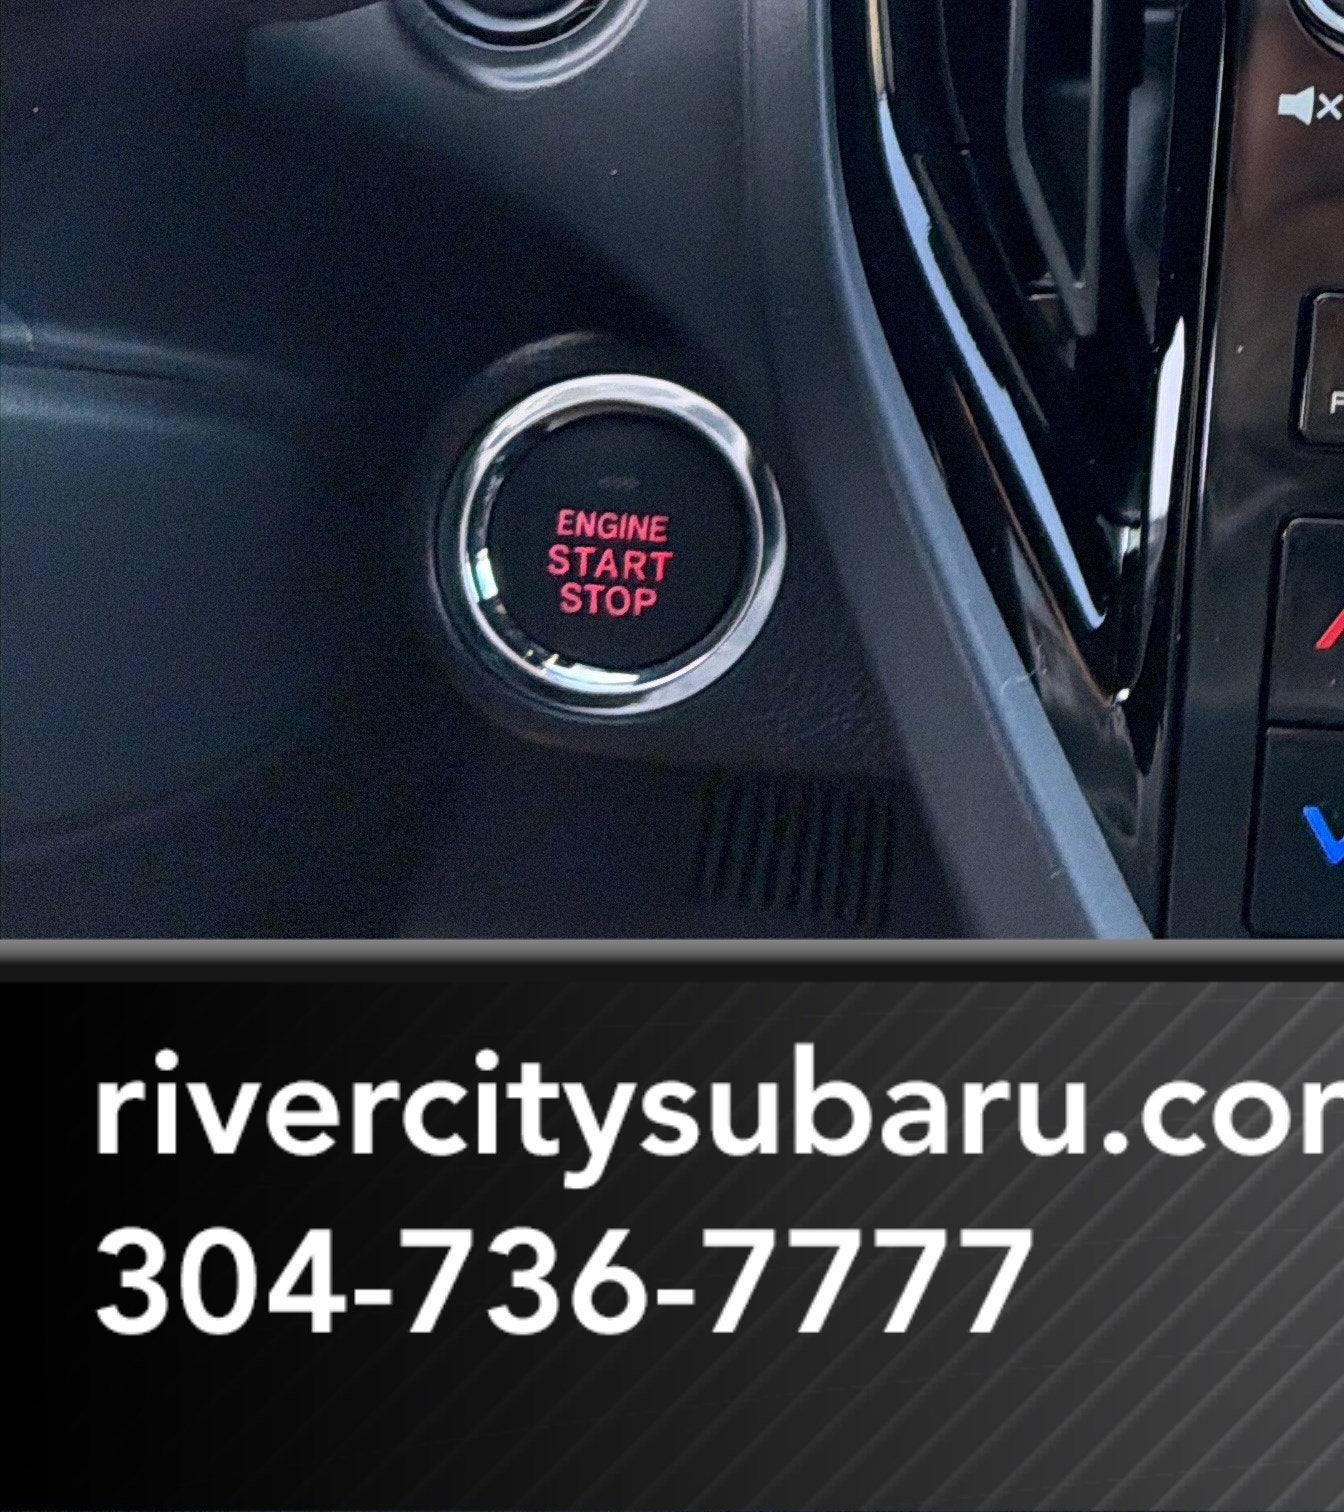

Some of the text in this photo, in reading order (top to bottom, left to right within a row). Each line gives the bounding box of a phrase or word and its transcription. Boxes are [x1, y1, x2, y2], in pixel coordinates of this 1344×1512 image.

[554, 506, 672, 545] ENGINE
[544, 541, 676, 584] START
[558, 580, 660, 619] STOP
